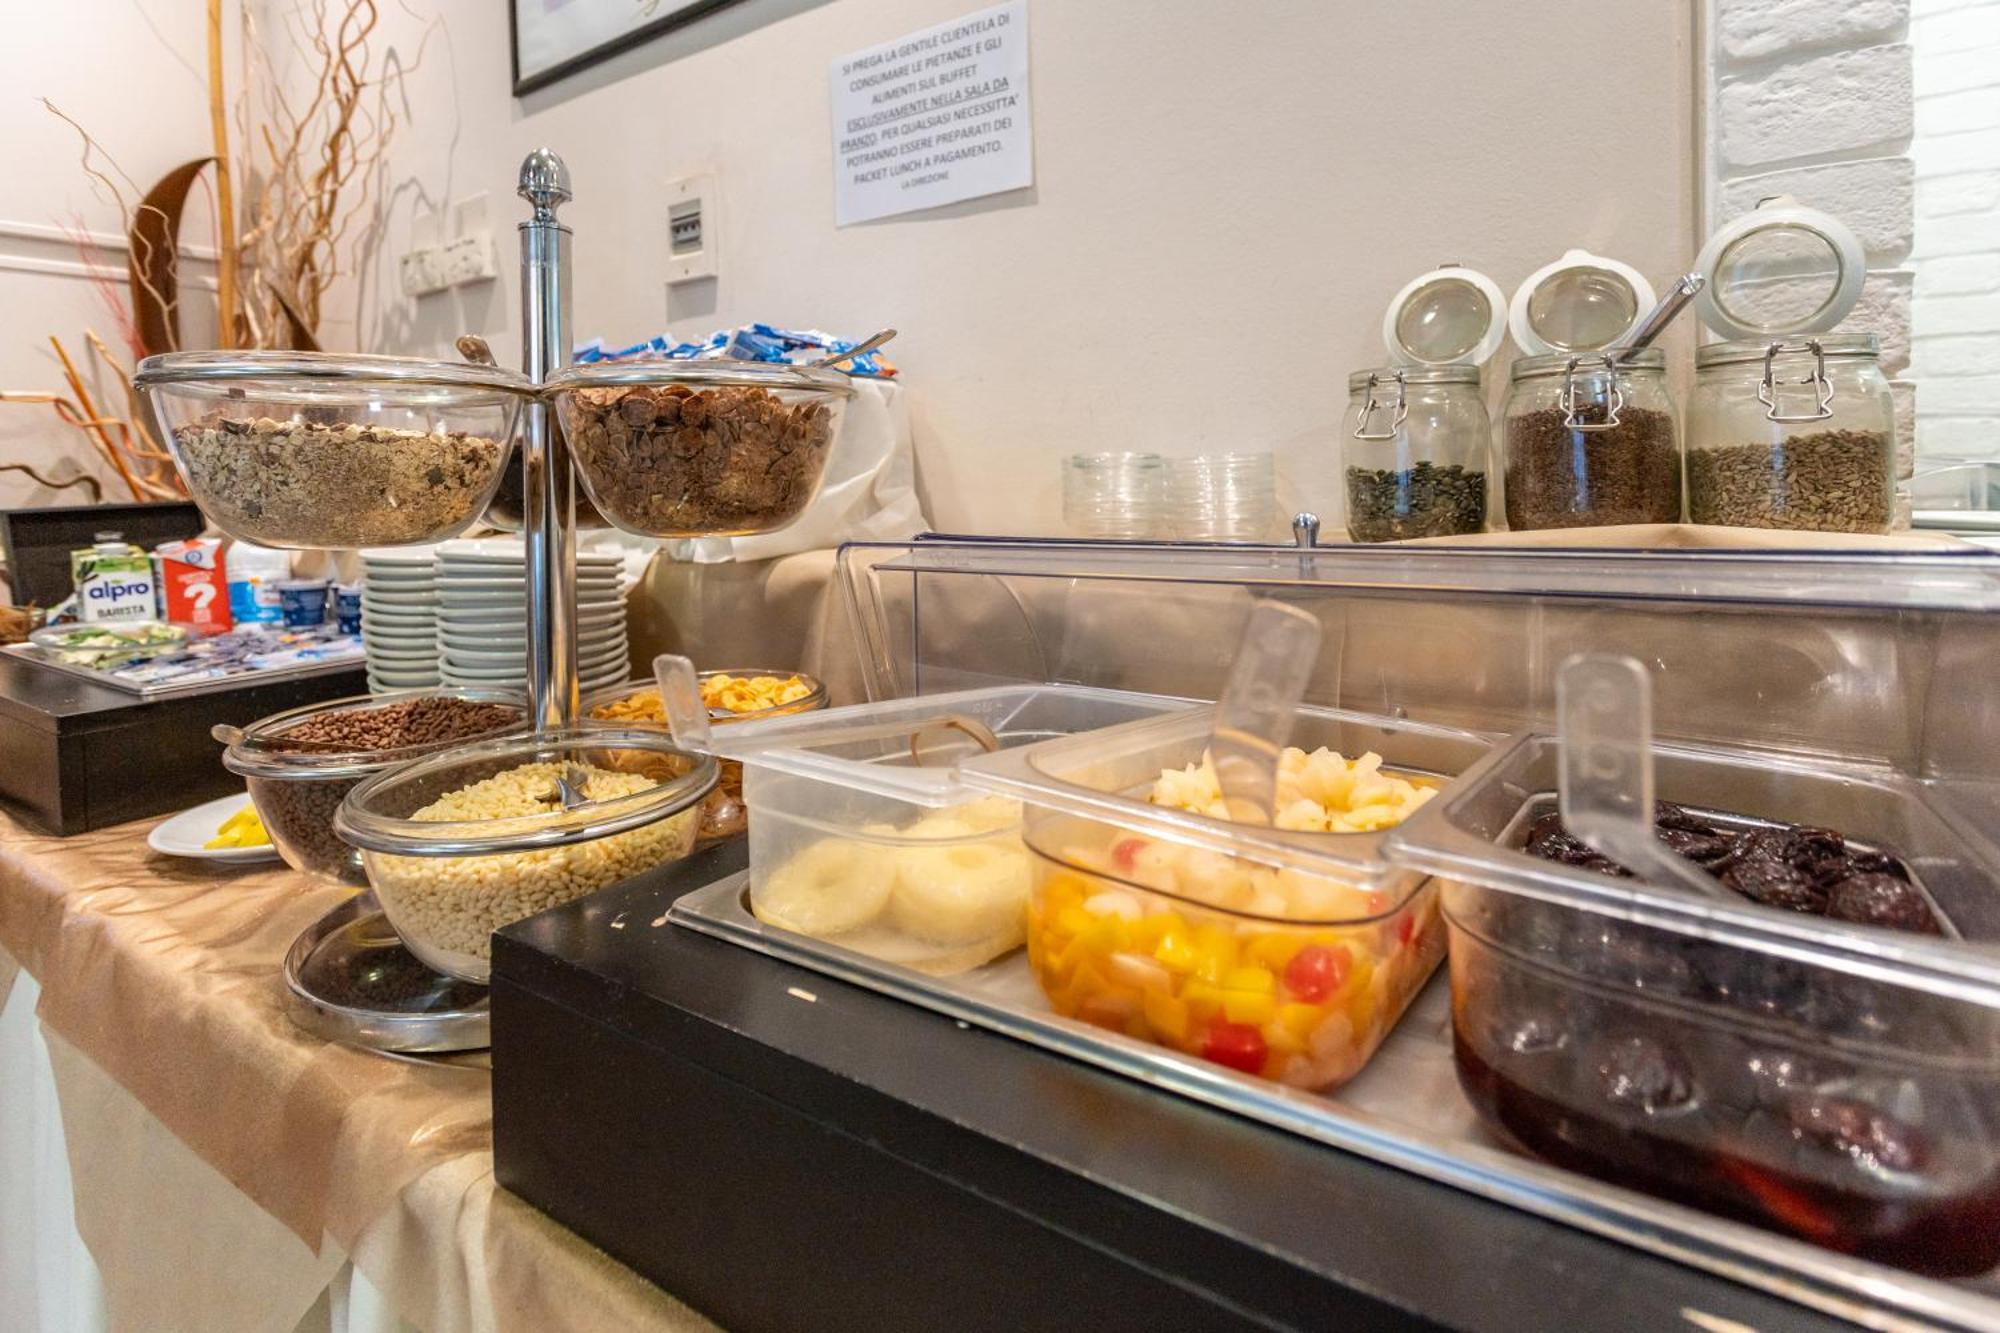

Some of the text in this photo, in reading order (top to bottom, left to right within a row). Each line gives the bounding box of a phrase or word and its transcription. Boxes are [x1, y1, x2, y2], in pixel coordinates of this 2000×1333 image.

[842, 13, 1010, 75] SI PREGA LA GENTILE CLIENTELA DI
[849, 37, 1002, 92] CONSUMARE LE PIETANZE E GLI
[872, 64, 977, 104] ALIMENTI SUL BUFFET
[847, 77, 1009, 133] ESCLUSIVAMENTE NELLA SALA DA
[847, 118, 1012, 168] POTRANNO ESSERE PREPARATI DEI
[881, 126, 899, 140] PER
[900, 113, 951, 136] QUALSIASI
[854, 168, 887, 184] PACKET
[890, 158, 921, 176] LUNCH
[923, 157, 930, 166] A
[89, 580, 149, 602] alpro
[97, 604, 146, 618] BARISTA
